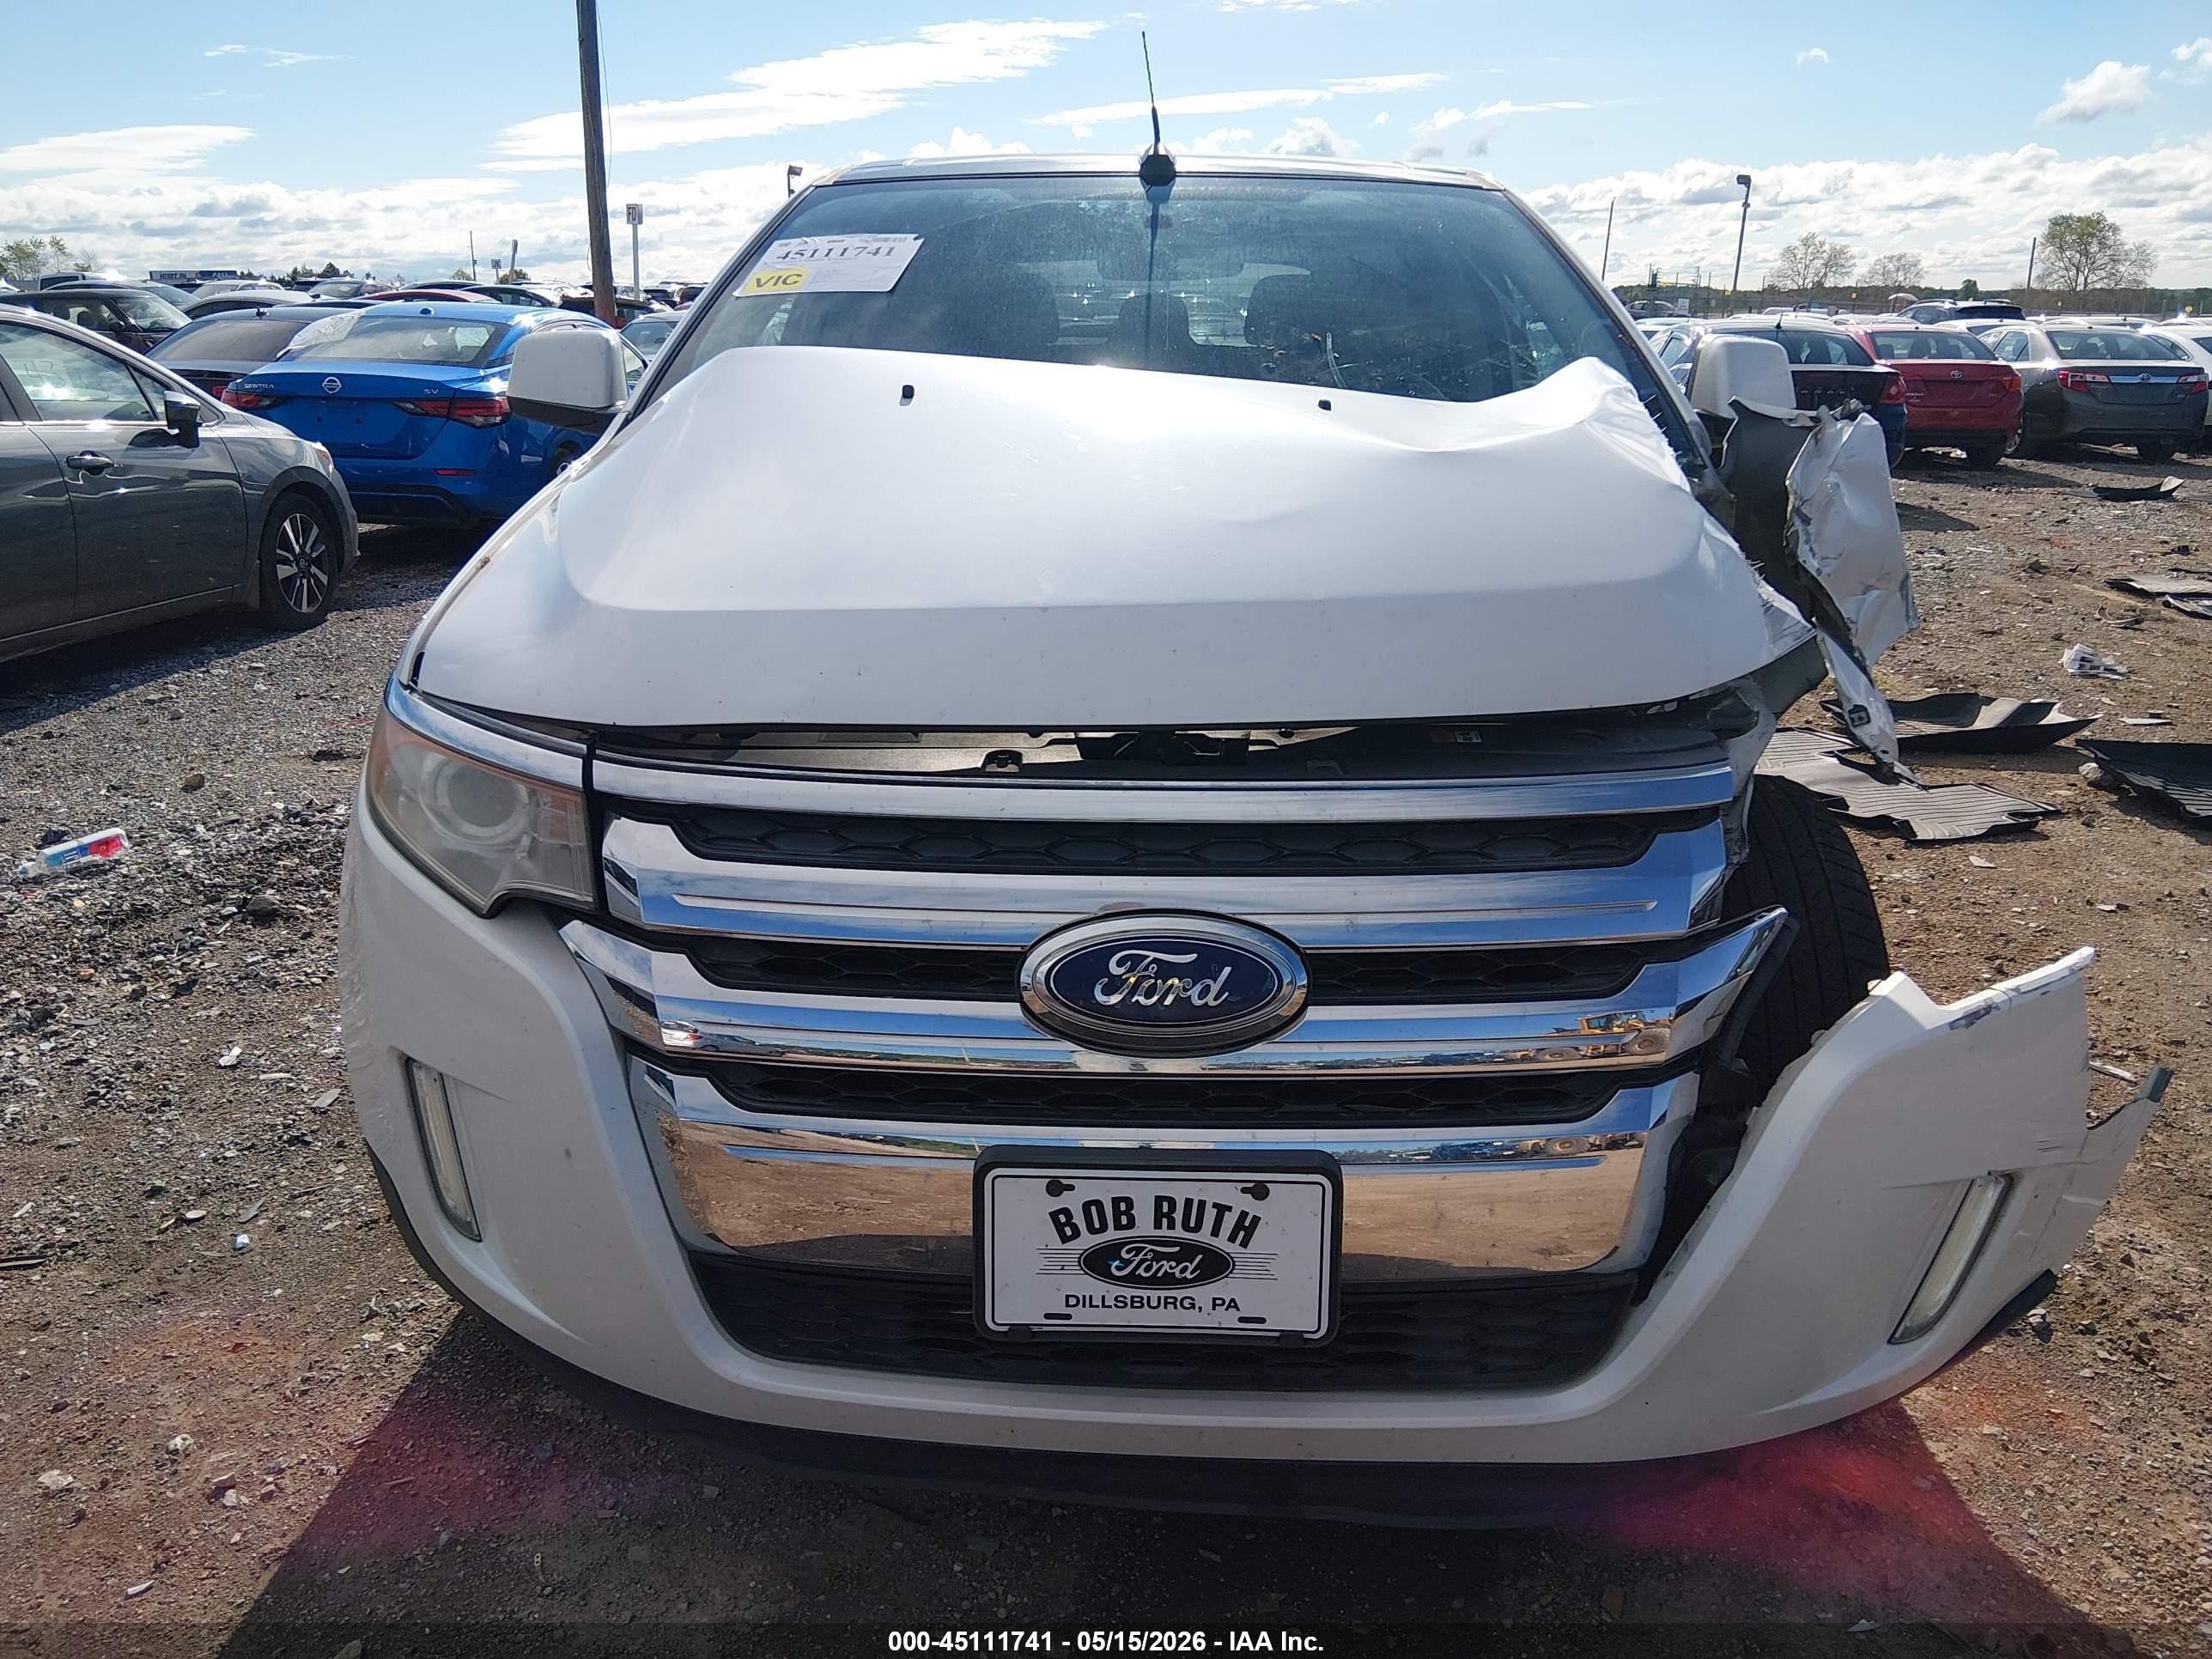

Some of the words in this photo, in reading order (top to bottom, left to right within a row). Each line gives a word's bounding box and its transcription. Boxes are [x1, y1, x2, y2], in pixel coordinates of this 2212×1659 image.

[628, 206, 636, 222] FD
[775, 246, 896, 260] 45111741
[755, 273, 804, 289] VIC
[1094, 949, 1232, 1006] Ford
[1048, 1195, 1136, 1244] BOB
[1153, 1194, 1262, 1249] RUTH
[1110, 1243, 1202, 1279] Ford
[1064, 1293, 1203, 1313] DILLSBURG,
[1212, 1297, 1241, 1312] PA
